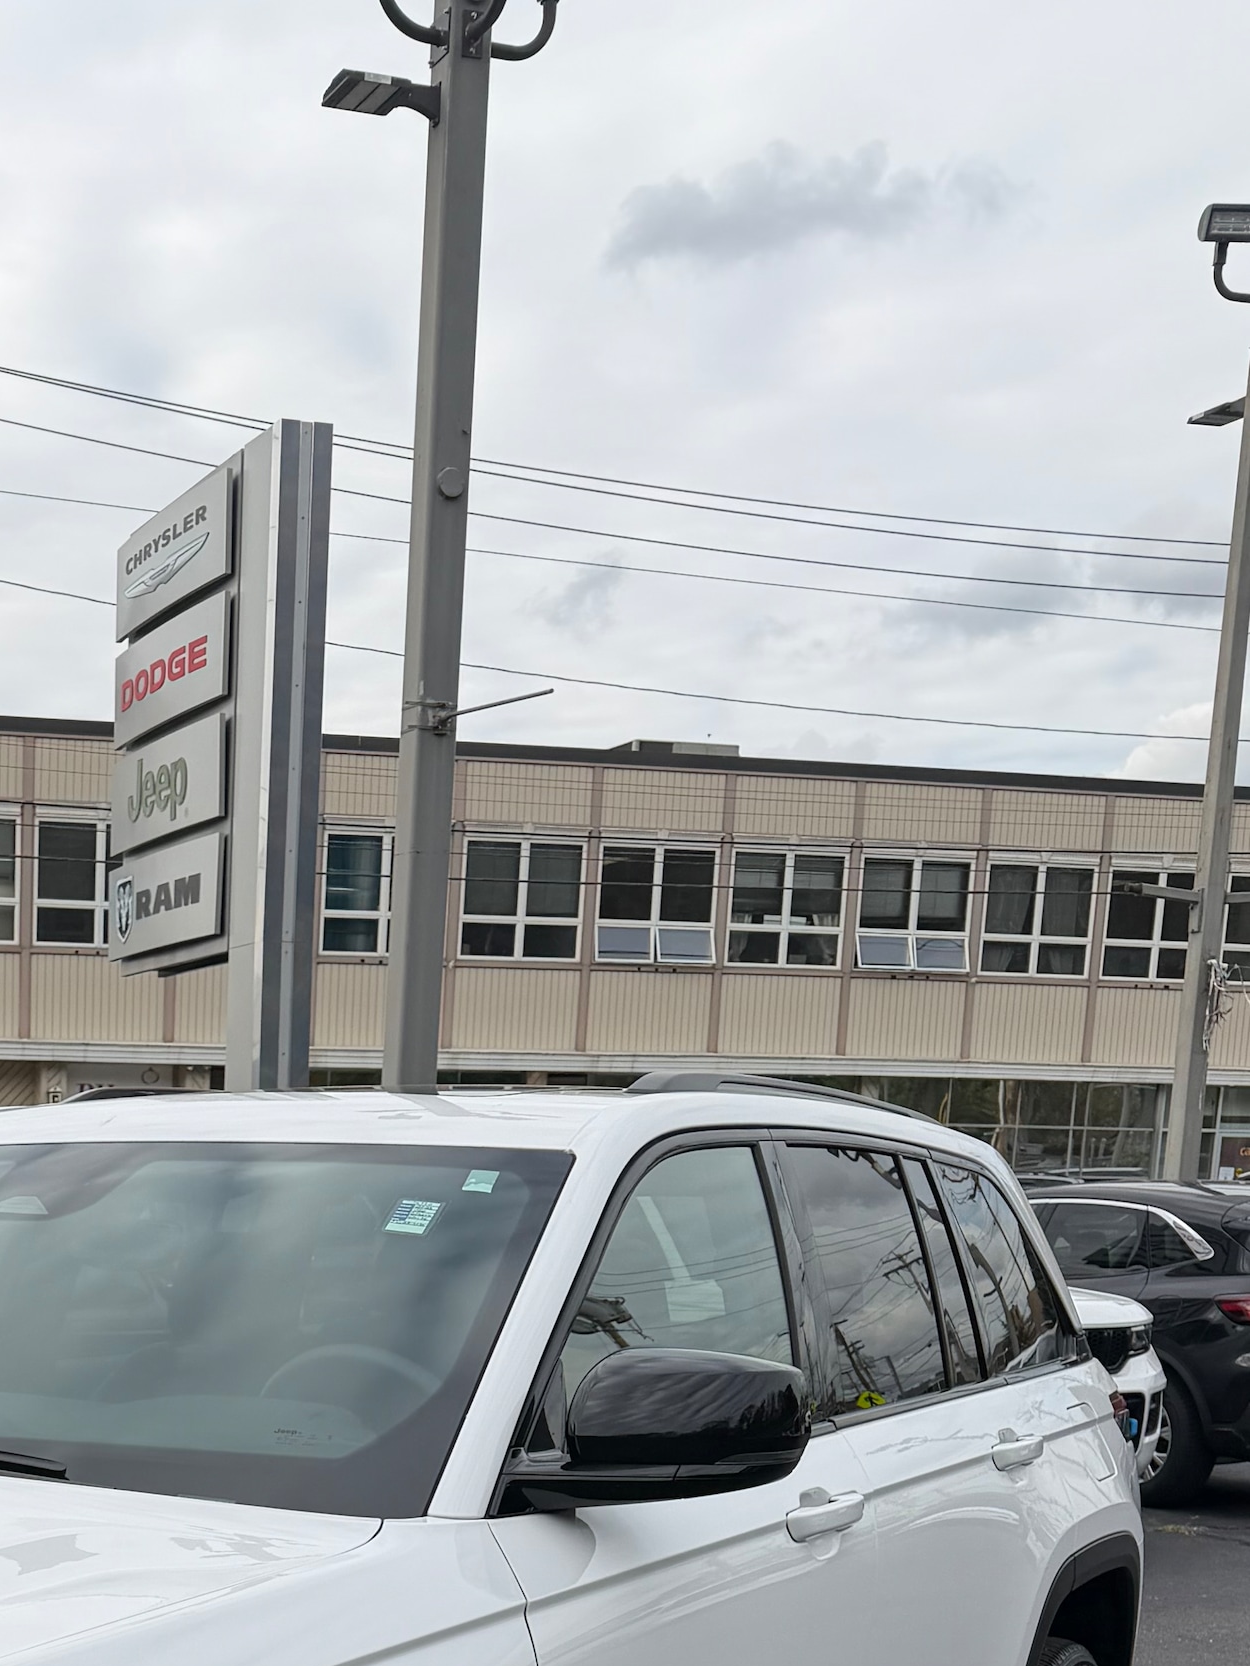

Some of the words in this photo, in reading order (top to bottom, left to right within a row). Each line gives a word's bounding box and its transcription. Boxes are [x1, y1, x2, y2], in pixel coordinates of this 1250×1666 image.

[125, 504, 208, 575] CHRYSLER
[120, 634, 208, 713] DODGE
[127, 756, 188, 823] Jeep
[135, 872, 202, 921] RAM
